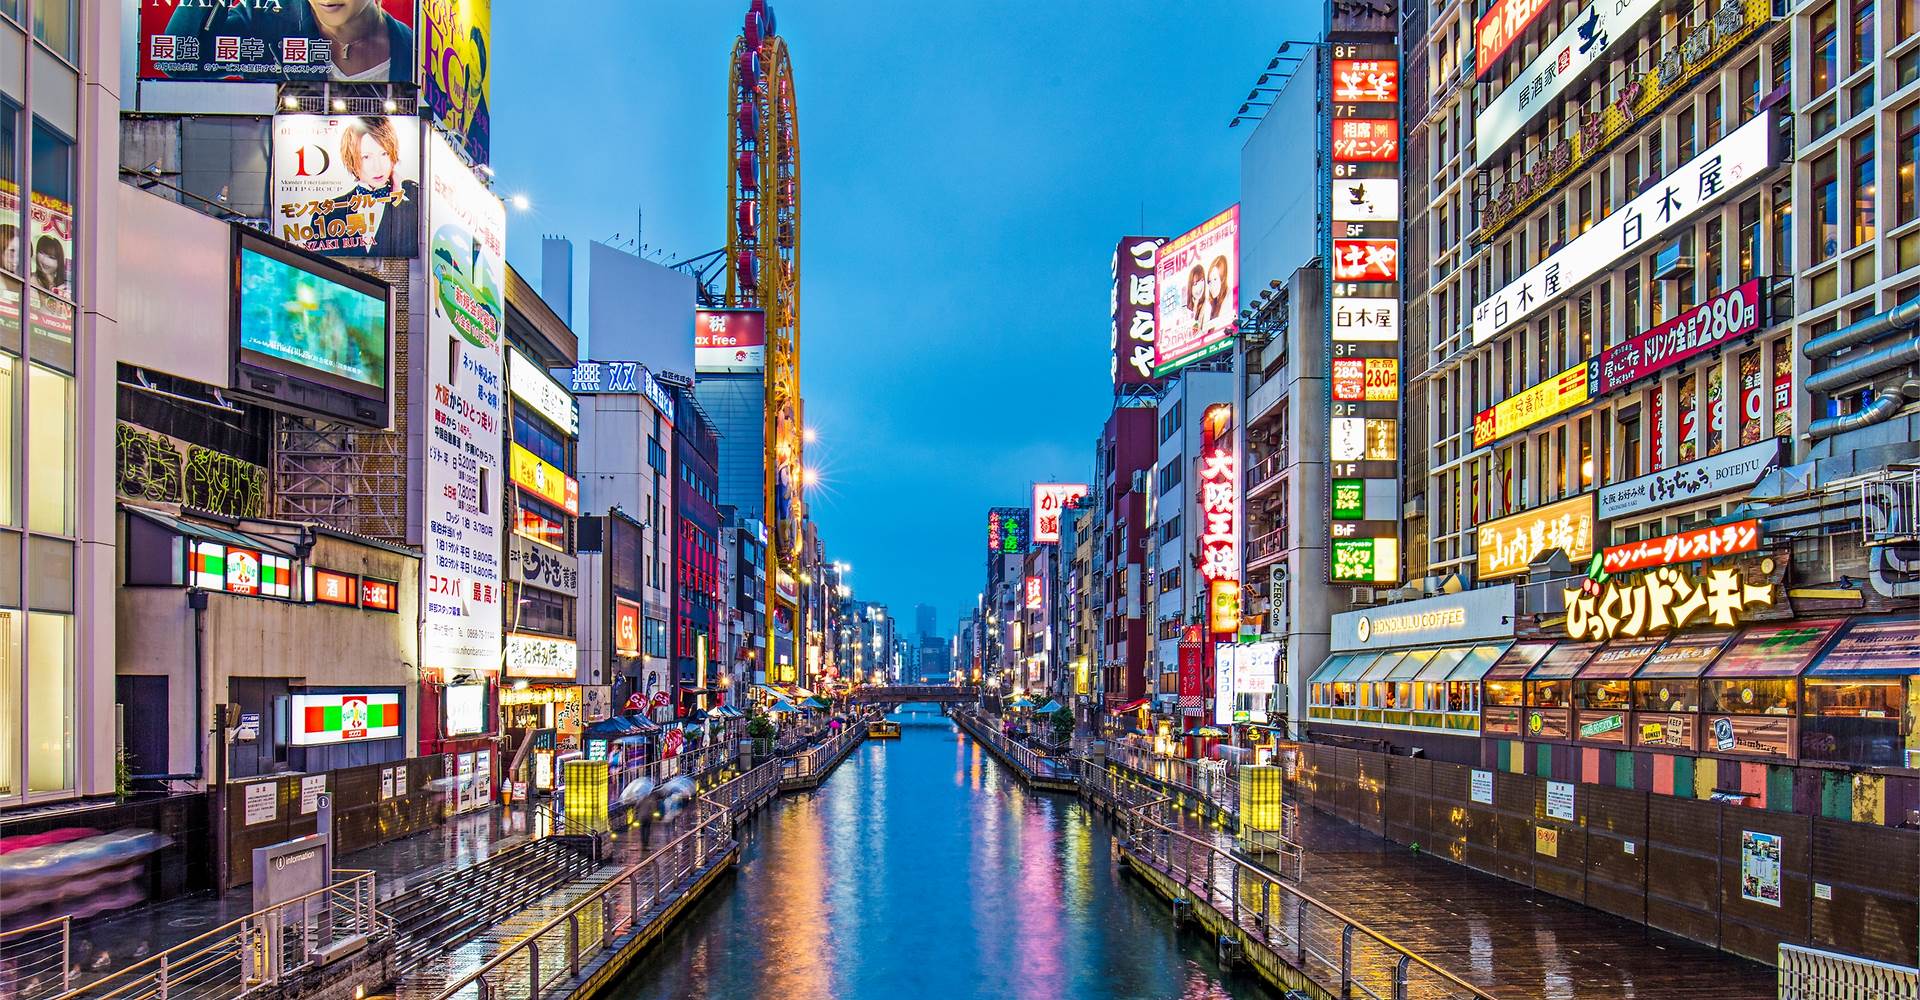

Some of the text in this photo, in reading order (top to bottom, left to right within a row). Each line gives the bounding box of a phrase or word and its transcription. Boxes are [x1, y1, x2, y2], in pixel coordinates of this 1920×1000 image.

[151, 35, 332, 64] 最強 最幸 最高
[1335, 46, 1356, 58] 8F
[1519, 61, 1557, 112] 居酒家
[1335, 106, 1356, 117] 7F
[1343, 122, 1371, 138] 相席
[1334, 139, 1397, 158] ダイニング
[1335, 165, 1356, 176] 6F
[281, 190, 405, 218] モンスターグループ
[1622, 154, 1725, 250] 白木屋
[283, 212, 375, 242] No.1の男!
[1346, 224, 1363, 236] 5F
[1335, 284, 1357, 296] 4F
[1476, 261, 1562, 329] 4F 白木屋
[1337, 306, 1392, 328] 白木屋
[1644, 289, 1755, 367] ドリンク全品280円
[695, 335, 736, 345] ax Free
[1335, 344, 1357, 356] 3F
[1335, 404, 1356, 416] 2F
[1335, 463, 1357, 476] 1F
[1715, 458, 1760, 481] BOTEJYU
[1602, 485, 1646, 506] 大阪 お好み焼
[1200, 449, 1234, 581] 大阪王将
[1333, 524, 1356, 536] B1F
[1481, 527, 1495, 547] 2F
[1605, 525, 1756, 568] ハンバーグレストラン
[1336, 549, 1371, 565] びっくり
[1334, 563, 1373, 578] ドンキー
[326, 578, 338, 598] 酒
[362, 585, 388, 604] たばこ
[429, 574, 498, 605] コスパ 最高!
[1273, 582, 1282, 608] ZERO
[1562, 566, 1773, 641] びっくりドンキー
[1372, 608, 1464, 634] HONOLULU COFFEE
[1669, 718, 1682, 727] KEEP
[285, 850, 315, 866] information
